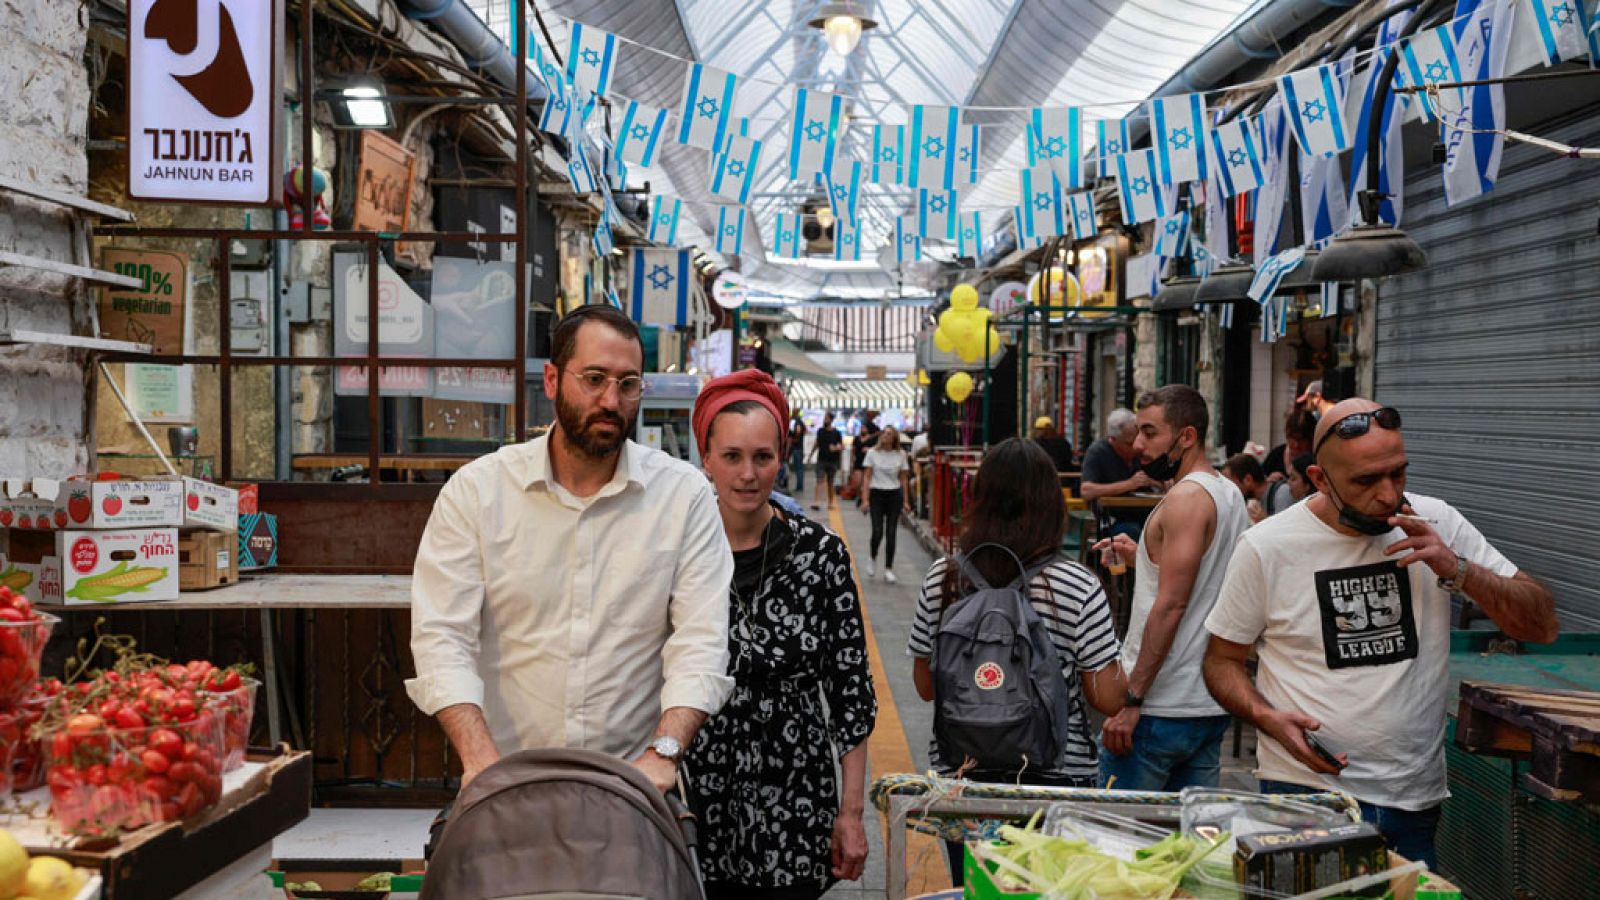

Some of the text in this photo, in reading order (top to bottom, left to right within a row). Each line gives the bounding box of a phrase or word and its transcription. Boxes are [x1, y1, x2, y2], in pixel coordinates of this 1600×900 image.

[143, 127, 253, 164] ג'חנונבר
[143, 166, 253, 182] JAHNUN BAR
[140, 543, 175, 560] החוף
[1338, 635, 1406, 659] LEAGUE
